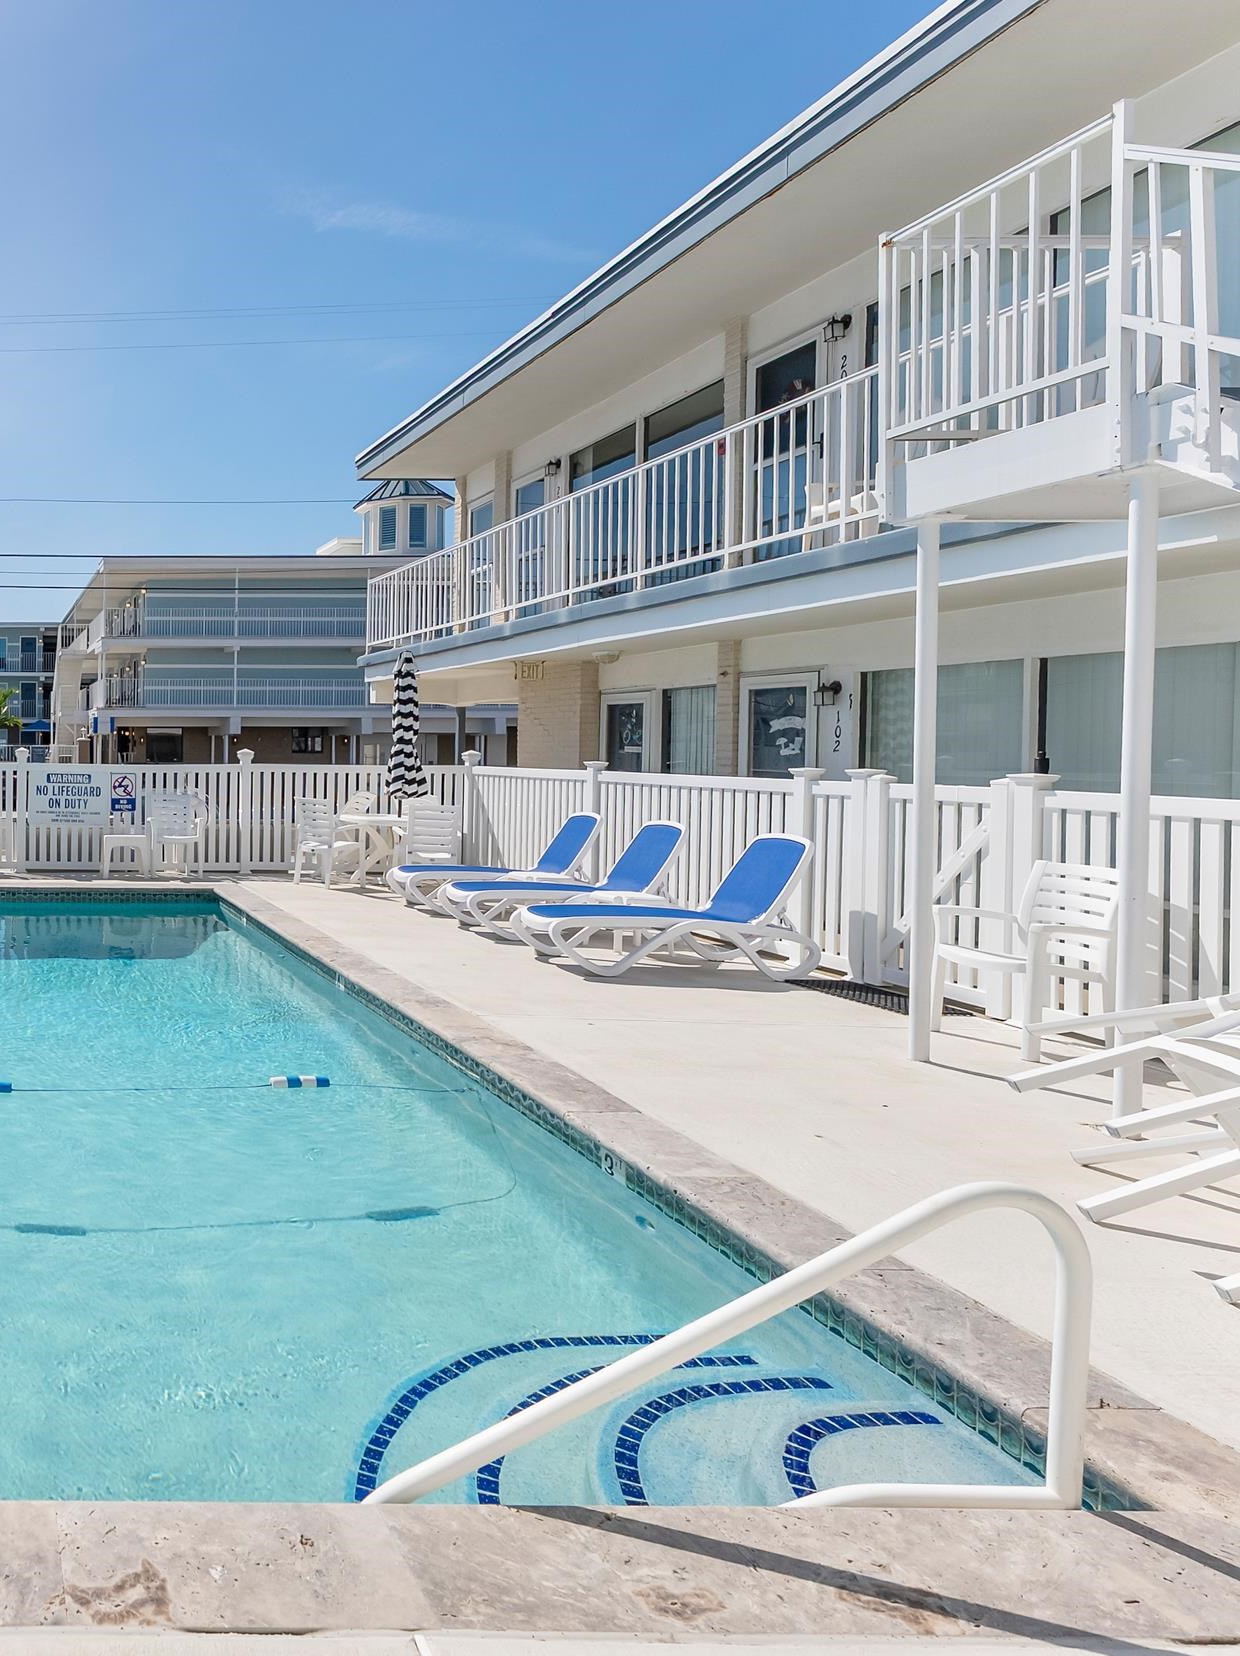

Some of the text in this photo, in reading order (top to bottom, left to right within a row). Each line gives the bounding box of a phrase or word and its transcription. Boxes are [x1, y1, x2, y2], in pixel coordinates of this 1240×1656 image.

[521, 664, 540, 679] EXIT
[833, 710, 842, 753] 102
[49, 774, 90, 784] WARNING
[36, 785, 101, 797] NO LIFEGUARD
[48, 798, 89, 810] ON DUTY
